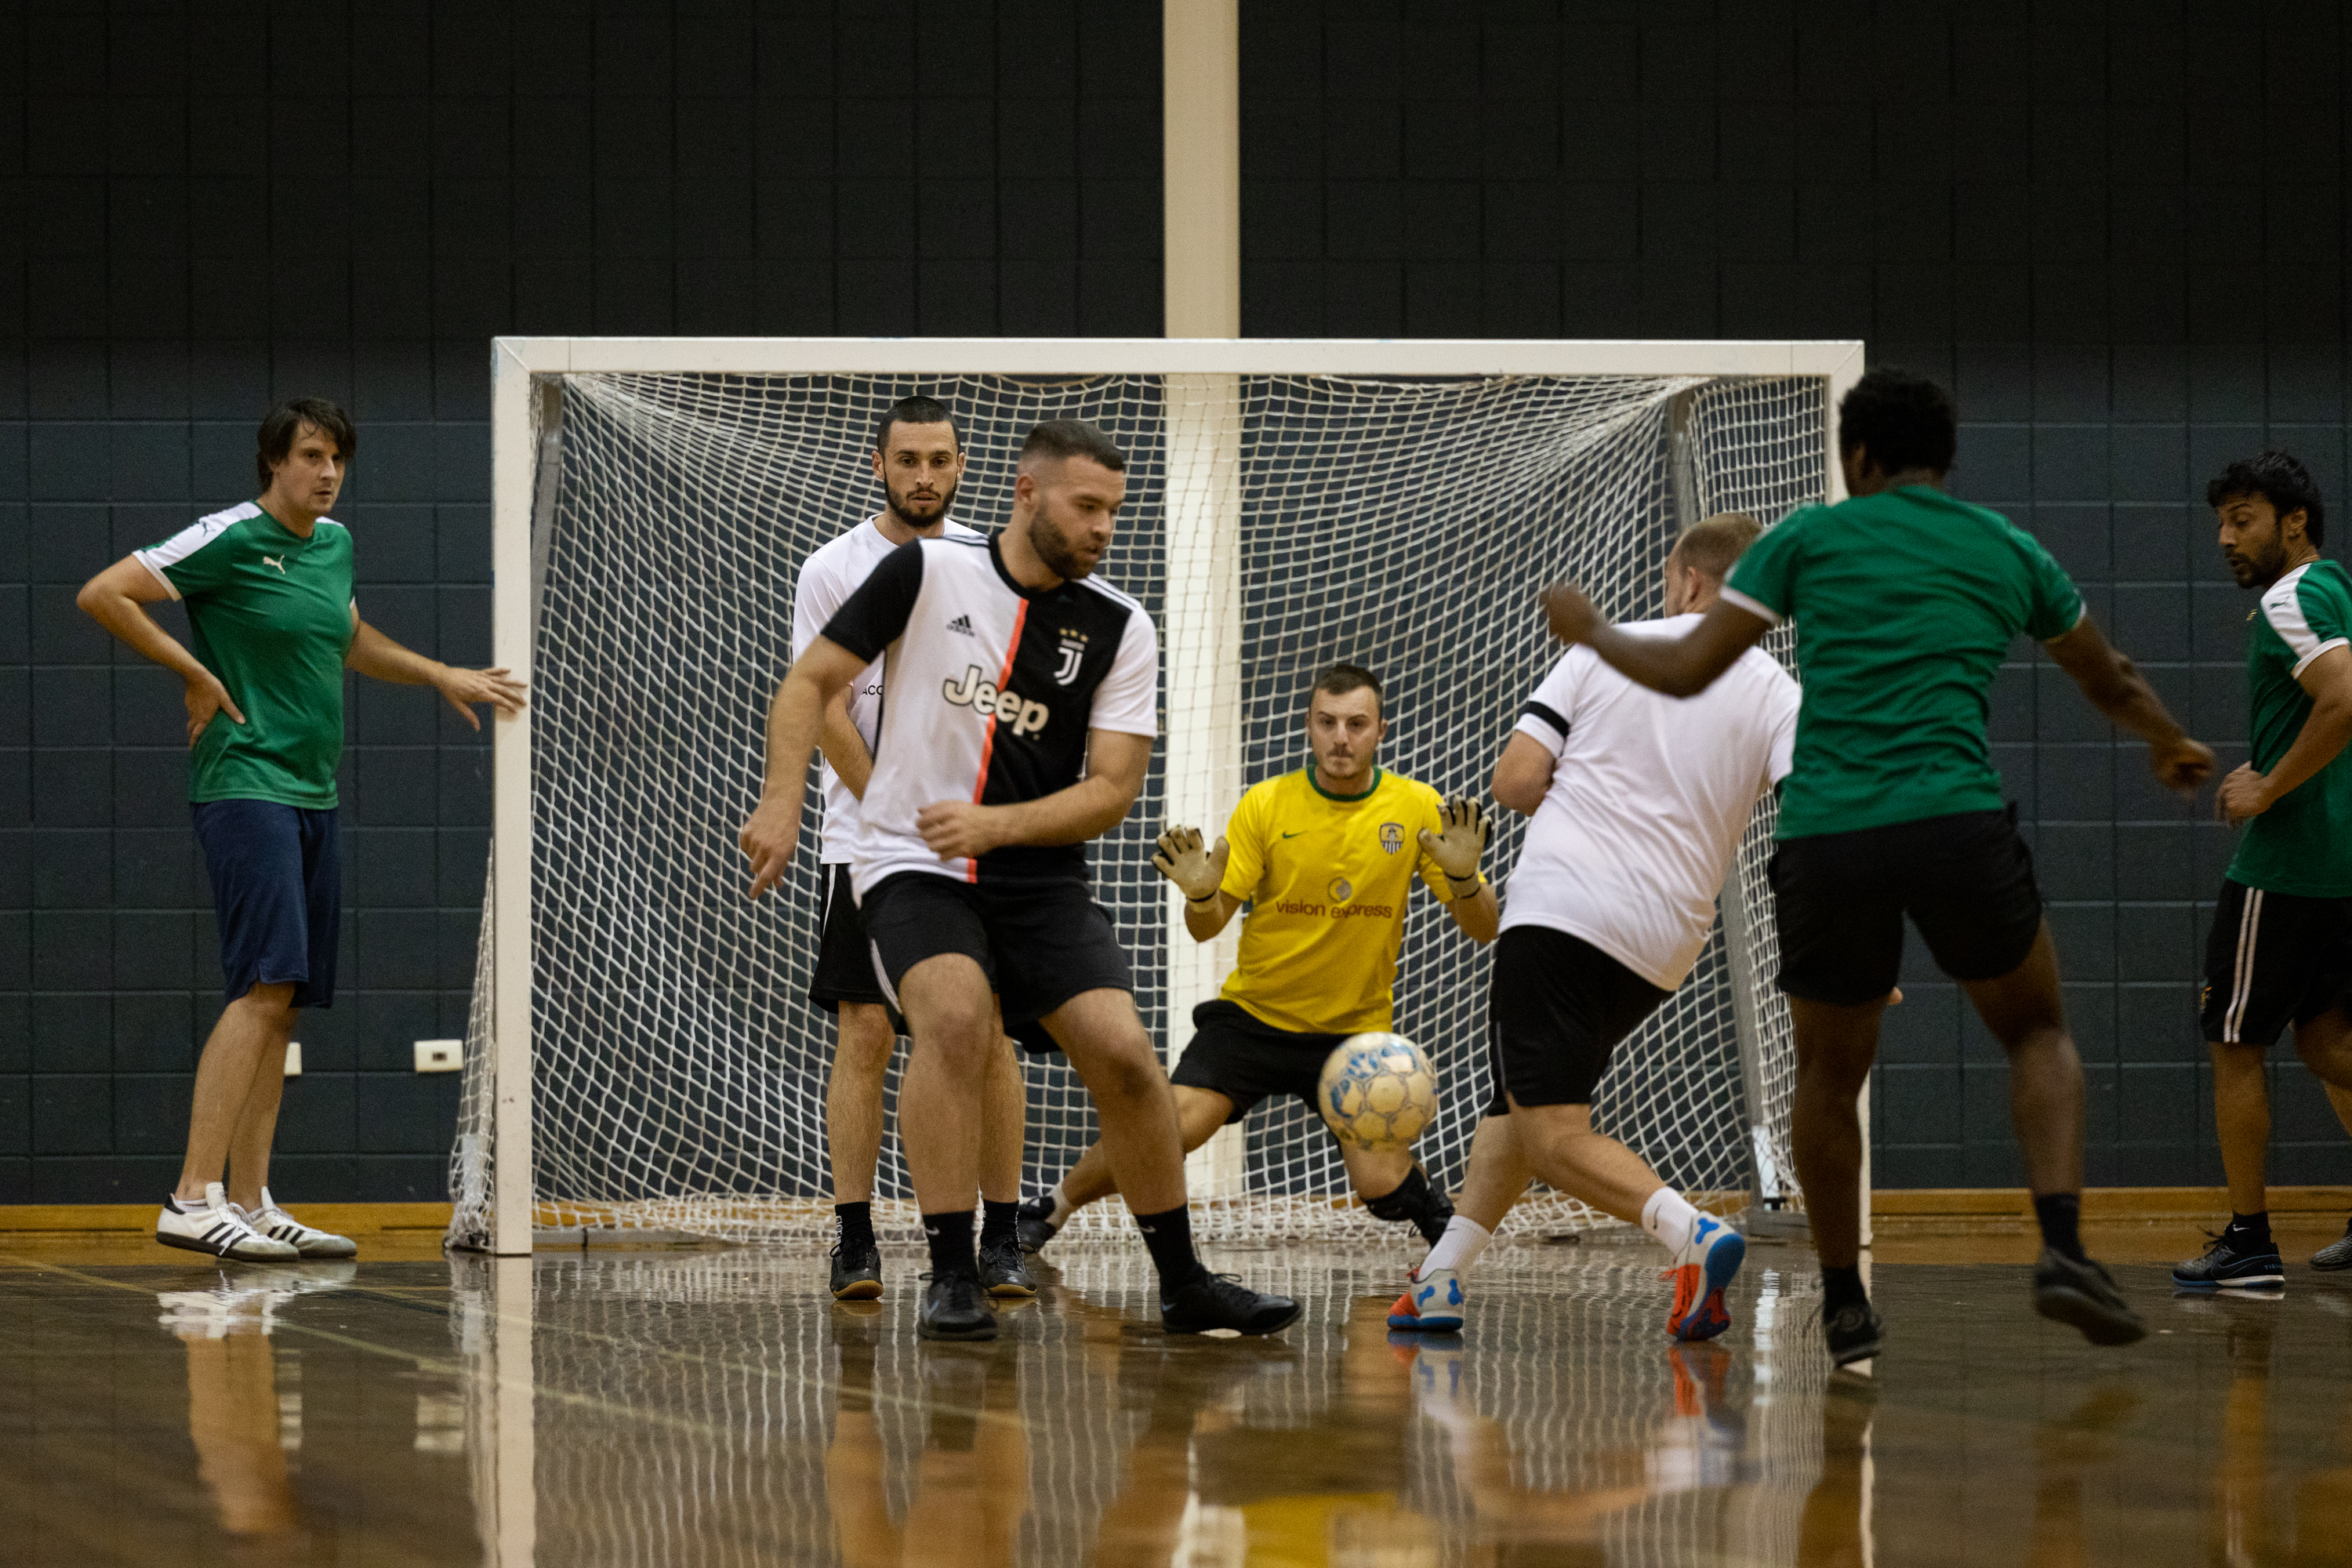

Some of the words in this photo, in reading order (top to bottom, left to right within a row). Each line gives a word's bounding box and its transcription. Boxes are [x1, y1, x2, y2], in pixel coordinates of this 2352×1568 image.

[942, 665, 1049, 735] Jeep
[1276, 900, 1326, 916] vision
[1330, 903, 1392, 919] express
